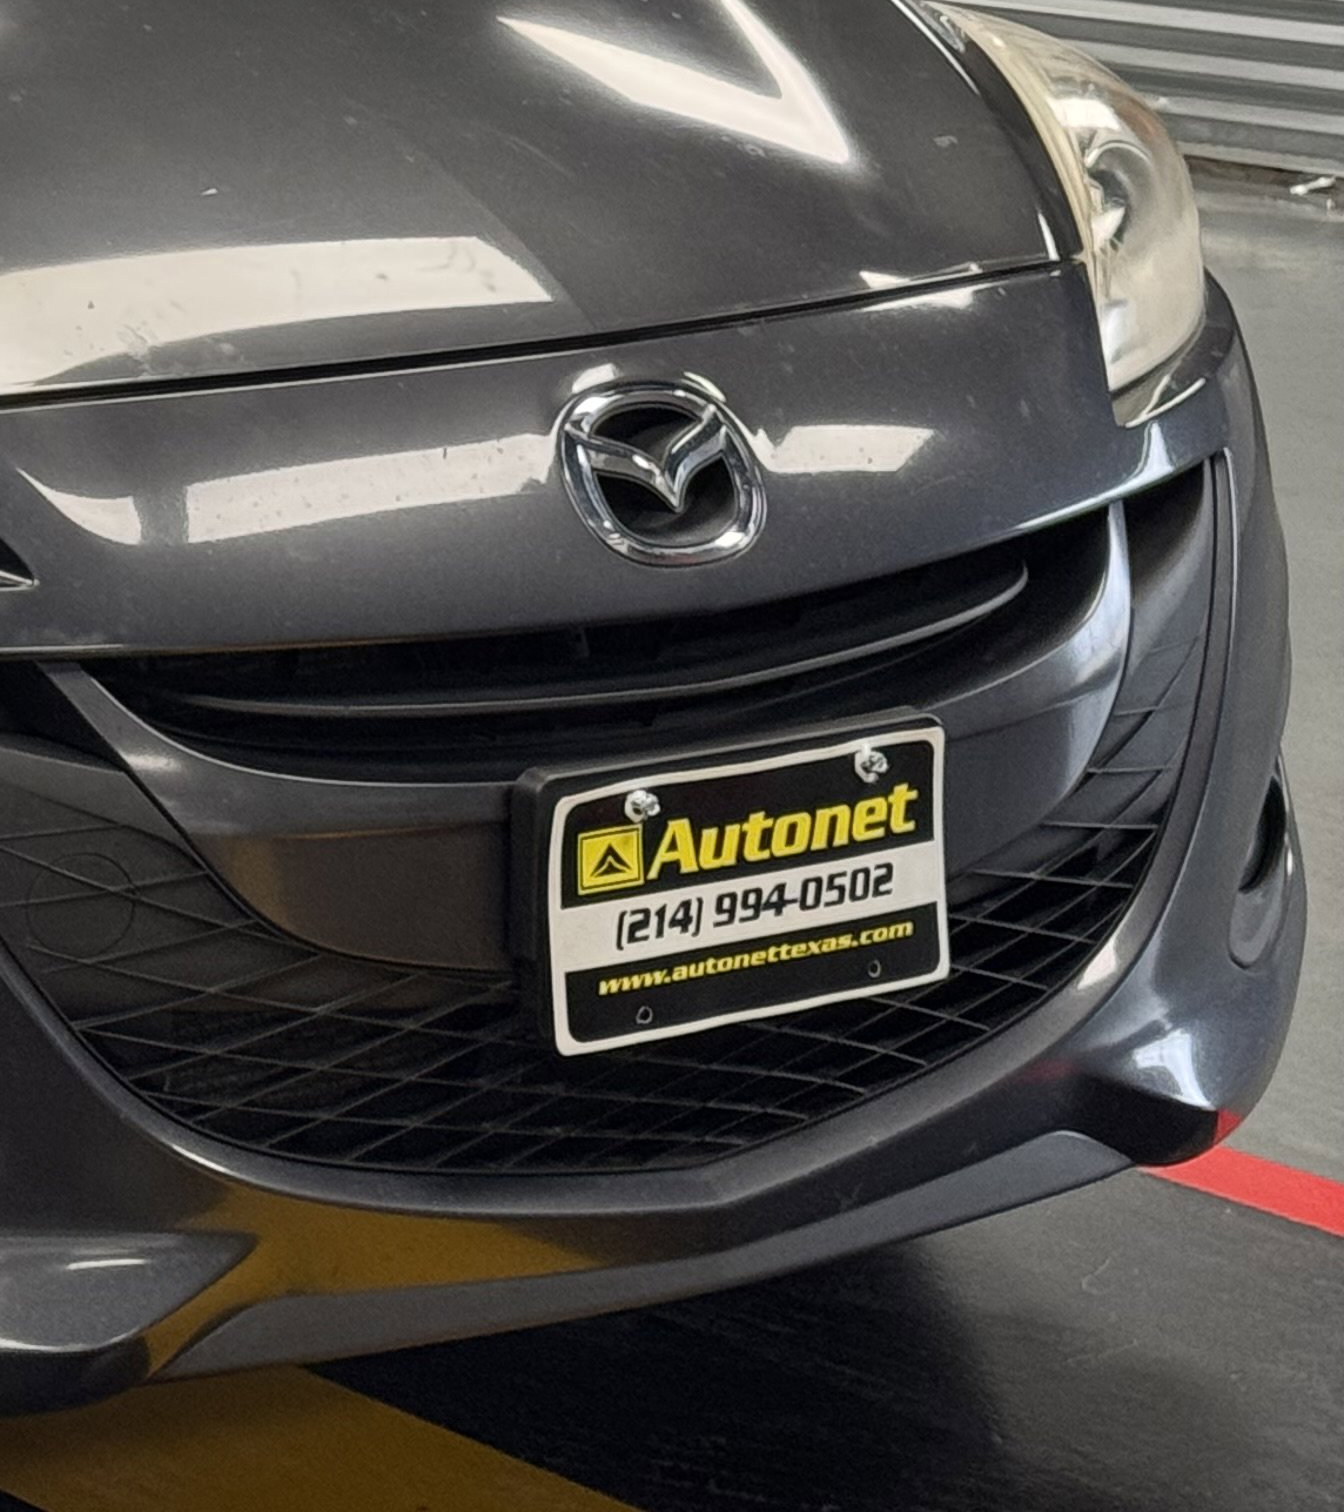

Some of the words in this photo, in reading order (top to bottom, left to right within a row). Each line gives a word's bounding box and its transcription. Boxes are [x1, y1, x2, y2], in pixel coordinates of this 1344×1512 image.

[647, 783, 918, 880] Autonet
[616, 896, 704, 950] (214)
[713, 862, 894, 928] 994-0502
[598, 920, 913, 996] www.autonettexas.com
